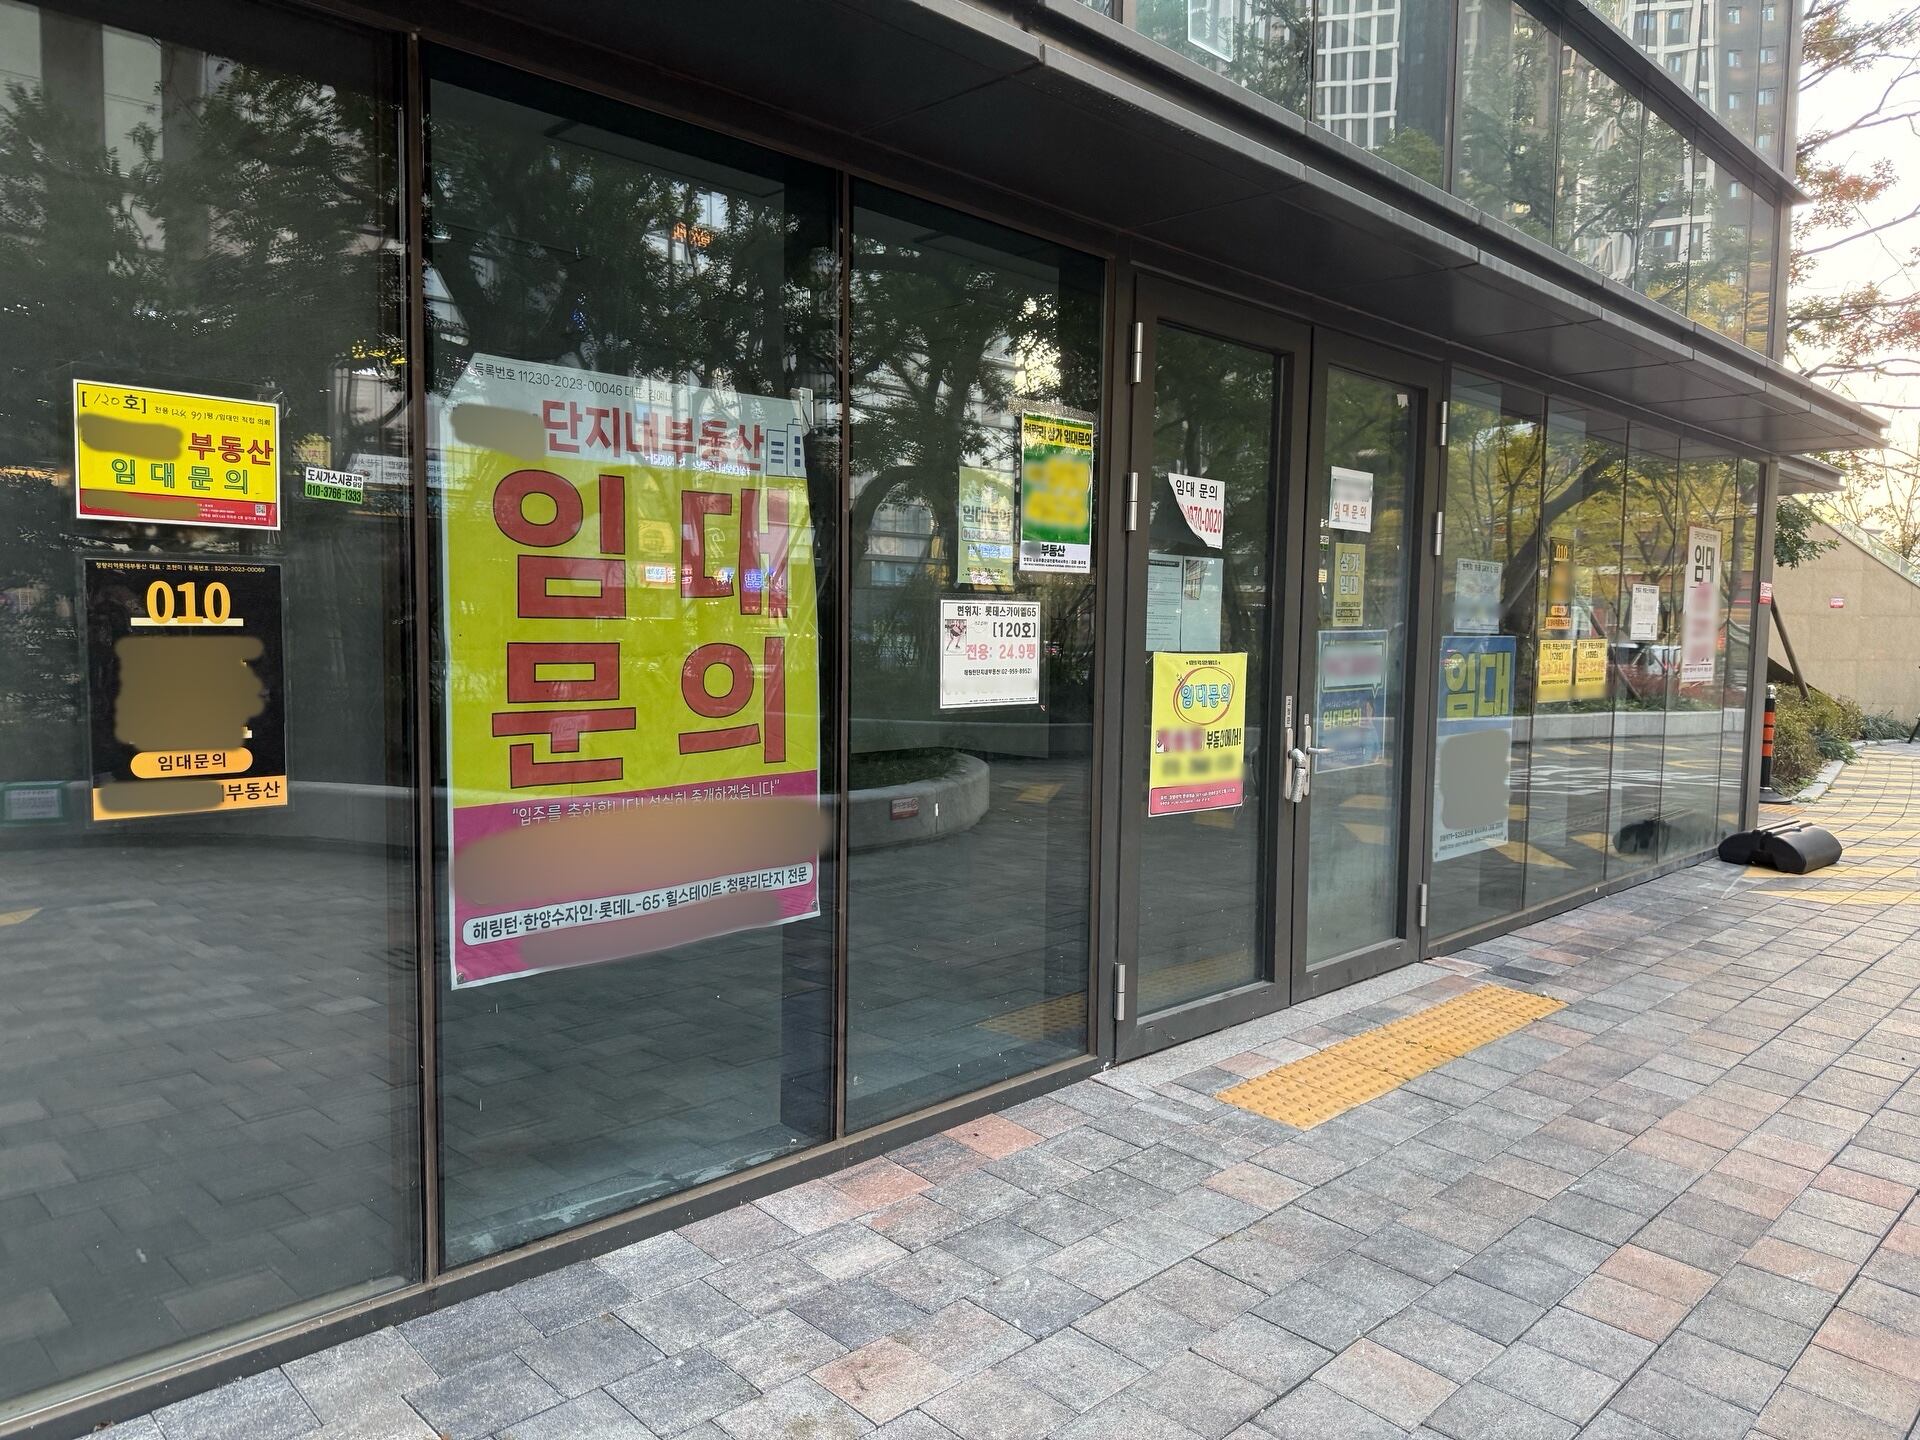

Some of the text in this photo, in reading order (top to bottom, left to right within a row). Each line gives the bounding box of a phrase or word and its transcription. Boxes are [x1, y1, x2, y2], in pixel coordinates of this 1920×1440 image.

[475, 362, 515, 381] 등록번호
[517, 370, 623, 396] 11230-2023-00046
[188, 432, 274, 466] 부동산
[111, 458, 249, 495] 임대문의
[307, 468, 353, 487] 도시가스시공
[307, 483, 362, 502] 010-3766-1333
[1175, 479, 1218, 501] 임대 문의
[492, 469, 790, 620] 임대
[1041, 543, 1066, 557] 부동산
[1694, 544, 1715, 583] 임대
[146, 580, 231, 625] 010
[985, 605, 1037, 618] 롯데스카이엘65
[993, 621, 1036, 639] [120호]
[966, 643, 1036, 661] 전용: 24.9평
[1180, 682, 1232, 709] 임대문의
[1445, 651, 1511, 722] 임대
[492, 637, 787, 789] 문의
[157, 752, 227, 771] 임대문의
[225, 780, 281, 802] 부동산
[786, 865, 808, 884] 전문
